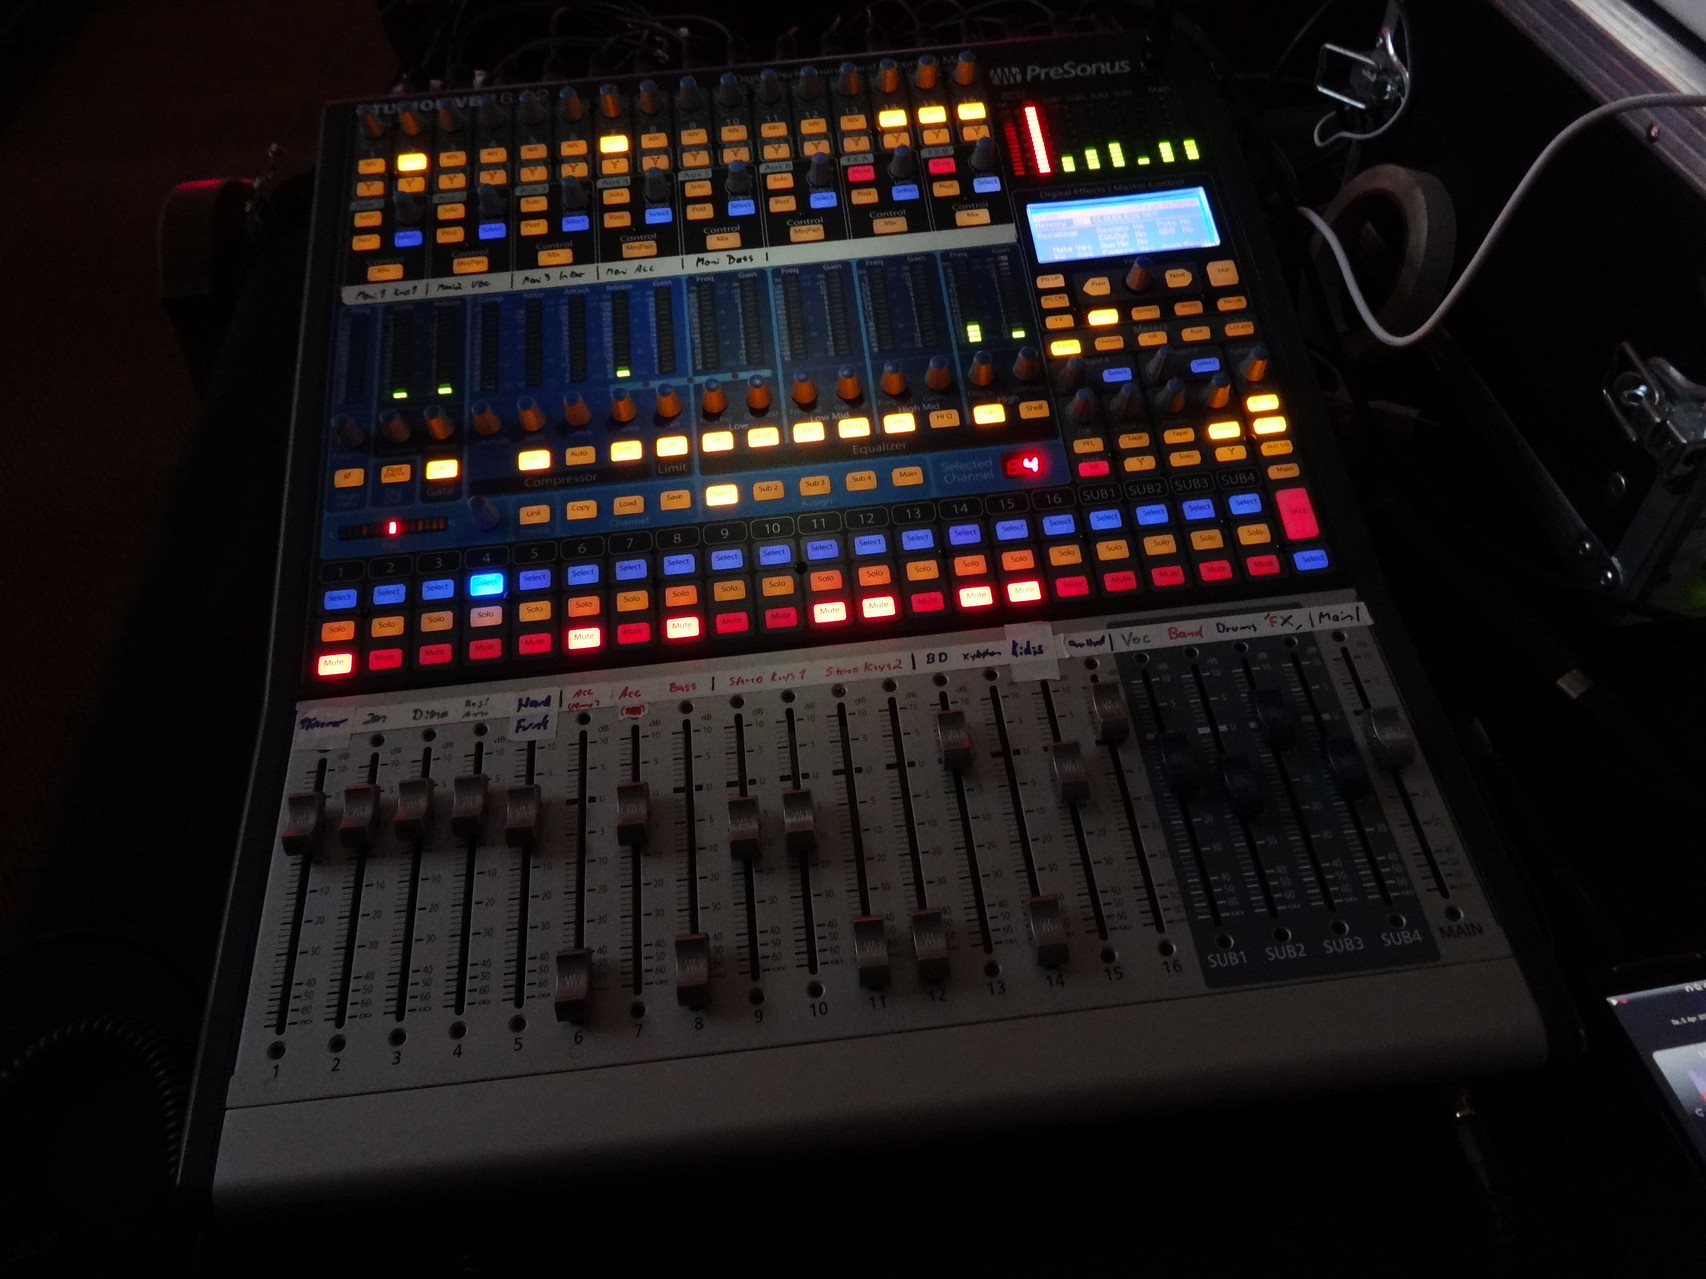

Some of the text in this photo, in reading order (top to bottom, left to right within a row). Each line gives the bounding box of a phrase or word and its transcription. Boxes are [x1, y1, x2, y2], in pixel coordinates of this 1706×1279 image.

[1027, 60, 1131, 82] PreSonus
[952, 201, 988, 210] Control
[870, 209, 906, 218] Control
[787, 217, 824, 227] Control
[703, 225, 740, 234] Control
[620, 232, 657, 242] Control
[696, 254, 754, 267] Moni Bass
[922, 402, 940, 411] Mid
[832, 411, 850, 420] Mid
[729, 422, 749, 430] Low
[852, 442, 907, 456] Equalizer
[658, 463, 688, 474] Limit
[941, 458, 992, 473] Selected
[1022, 457, 1039, 472] 4
[524, 472, 599, 489] Compressor
[944, 469, 994, 483] Channel
[1221, 473, 1255, 486] SUB4
[1129, 483, 1162, 496] SUB2
[1175, 478, 1209, 491] SUB3
[1046, 493, 1062, 504] 16
[1082, 488, 1115, 500] SUB1
[1000, 498, 1015, 510] 15
[1236, 498, 1258, 506] Select
[571, 504, 591, 512] Copy
[953, 503, 968, 514] 14
[1142, 508, 1165, 516] Select
[1188, 503, 1211, 512] Select
[860, 513, 874, 524] 12
[906, 508, 921, 519] 13
[1096, 513, 1118, 521] Select
[812, 518, 826, 529] 11
[1049, 518, 1071, 526] Select
[764, 522, 781, 534] 10
[1001, 524, 1024, 532] Select
[1247, 529, 1264, 537] Solo
[673, 533, 682, 544] 8
[720, 528, 729, 539] 9
[906, 534, 929, 542] Select
[1199, 534, 1216, 542] Solo
[626, 537, 634, 549] 7
[810, 543, 834, 551] Select
[858, 538, 882, 546] Select
[1153, 539, 1170, 547] Solo
[578, 543, 587, 553] 6
[763, 549, 785, 557] Select
[1058, 549, 1075, 557] Solo
[1105, 544, 1123, 552] Solo
[482, 553, 491, 563] 4
[530, 548, 538, 559] 5
[715, 553, 738, 561] Select
[435, 557, 442, 569] 3
[667, 558, 690, 566] Select
[962, 560, 980, 568] Solo
[1010, 555, 1027, 563] Solo
[386, 562, 394, 574] 2
[619, 563, 641, 571] Select
[914, 565, 932, 573] Solo
[339, 567, 343, 578] 1
[572, 569, 594, 577] Select
[866, 570, 883, 578] Solo
[523, 574, 546, 582] Select
[817, 575, 834, 583] Solo
[426, 583, 448, 592] Select
[721, 585, 738, 593] Solo
[769, 580, 786, 588] Solo
[328, 593, 351, 601] Select
[377, 588, 400, 596] Select
[966, 591, 987, 599] Mute
[623, 595, 640, 603] Solo
[526, 606, 544, 614] Solo
[868, 601, 889, 609] Mute
[477, 611, 494, 619] Solo
[771, 612, 792, 620] Mute
[820, 607, 840, 615] Mute
[428, 616, 445, 624] Solo
[1318, 611, 1355, 624] Main
[330, 625, 345, 633] Solo
[378, 621, 395, 629] Solo
[672, 621, 693, 629] Mute
[1216, 622, 1257, 634] Drums
[574, 632, 595, 640] Mute
[1168, 626, 1204, 640] Band
[1121, 632, 1151, 647] Voc
[323, 659, 344, 667] Mute
[619, 686, 641, 699] Acc
[669, 682, 697, 693] Bass
[573, 688, 593, 698] Acc
[1439, 922, 1484, 940] MAIN
[1380, 929, 1422, 948] SUB4
[1323, 936, 1364, 954] SUB3
[1265, 944, 1307, 961] SUB2
[1208, 950, 1247, 968] SUB1
[1163, 959, 1182, 973] 16
[1105, 967, 1124, 981] 15
[1046, 974, 1064, 988] 14
[987, 981, 1006, 995] 13
[930, 988, 947, 1002] 12
[869, 995, 886, 1010] 11
[809, 1002, 828, 1016] 10
[754, 1010, 763, 1024] 9
[694, 1016, 704, 1030] 8
[634, 1024, 643, 1038] 7
[574, 1031, 584, 1045] 6
[514, 1037, 523, 1051] 5
[453, 1044, 463, 1058] 4
[392, 1051, 402, 1065] 3
[331, 1058, 341, 1072] 2
[273, 1064, 279, 1078] 1
